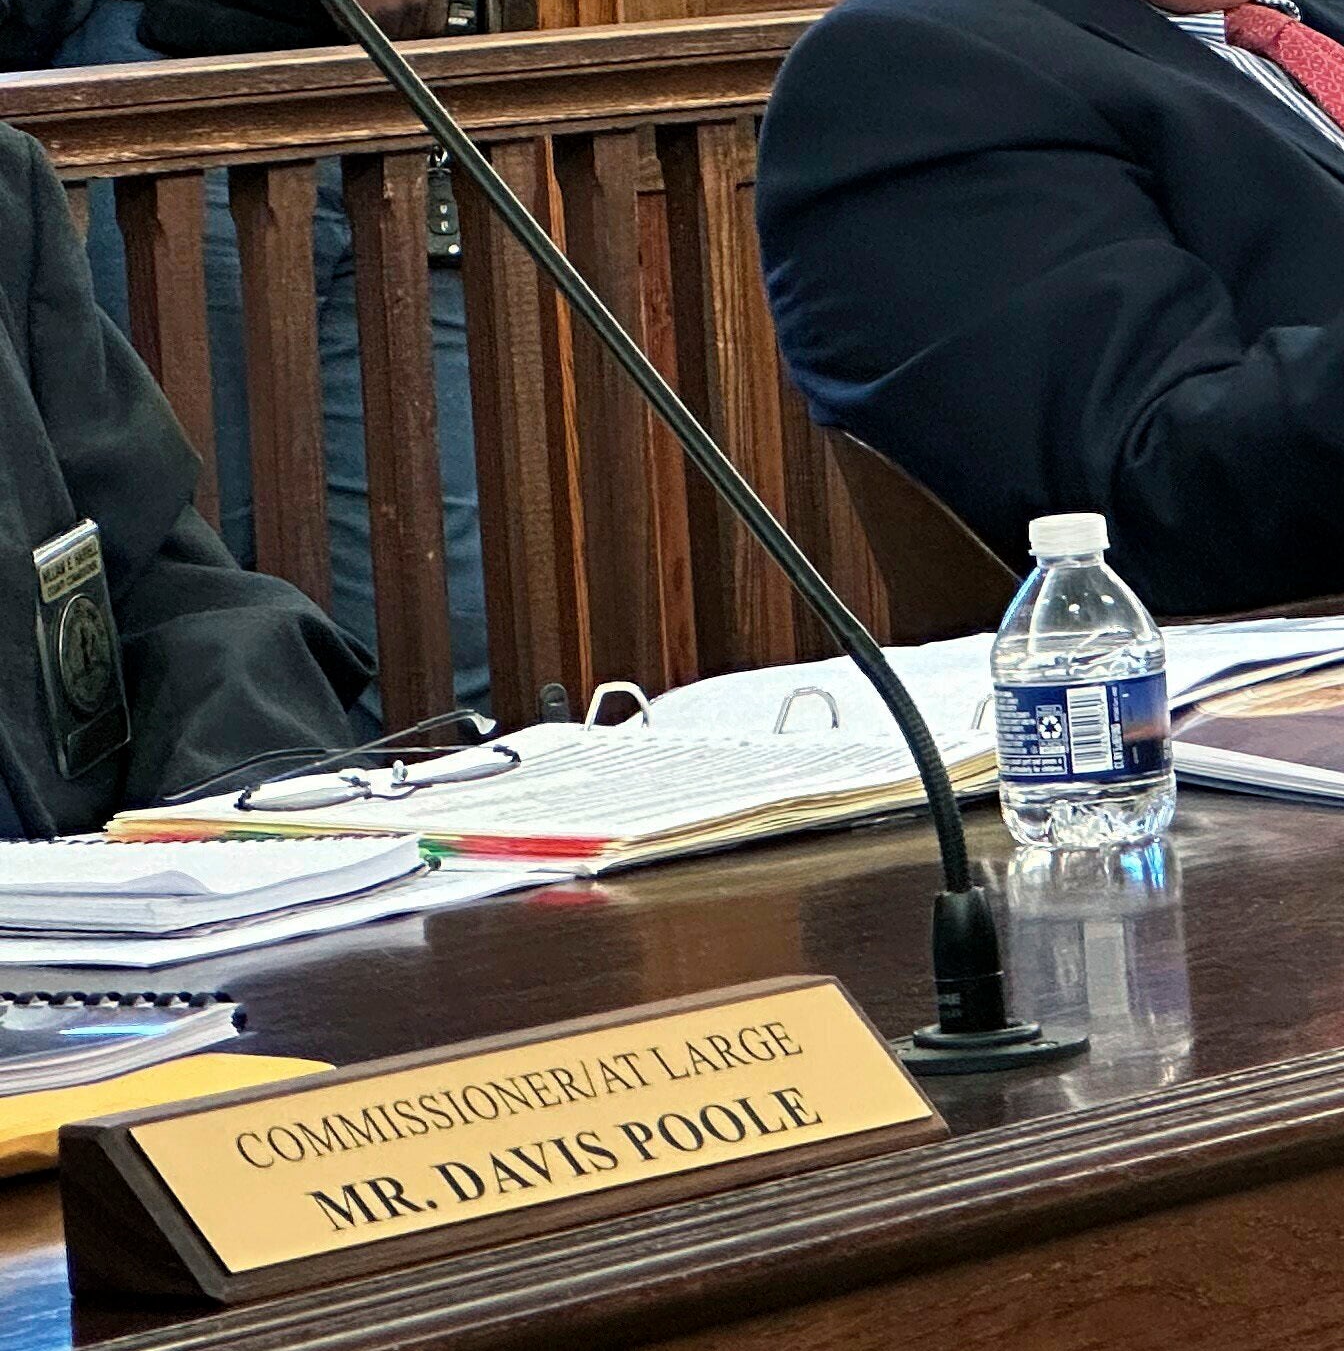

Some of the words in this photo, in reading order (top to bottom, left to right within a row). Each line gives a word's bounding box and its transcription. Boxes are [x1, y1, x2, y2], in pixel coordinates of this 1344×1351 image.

[235, 1052, 651, 1169] COMMISSIONER/AT
[647, 1021, 804, 1081] LARGE
[304, 1176, 438, 1231] MR.
[429, 1130, 620, 1203] DAVIS
[614, 1087, 823, 1161] POOLE
